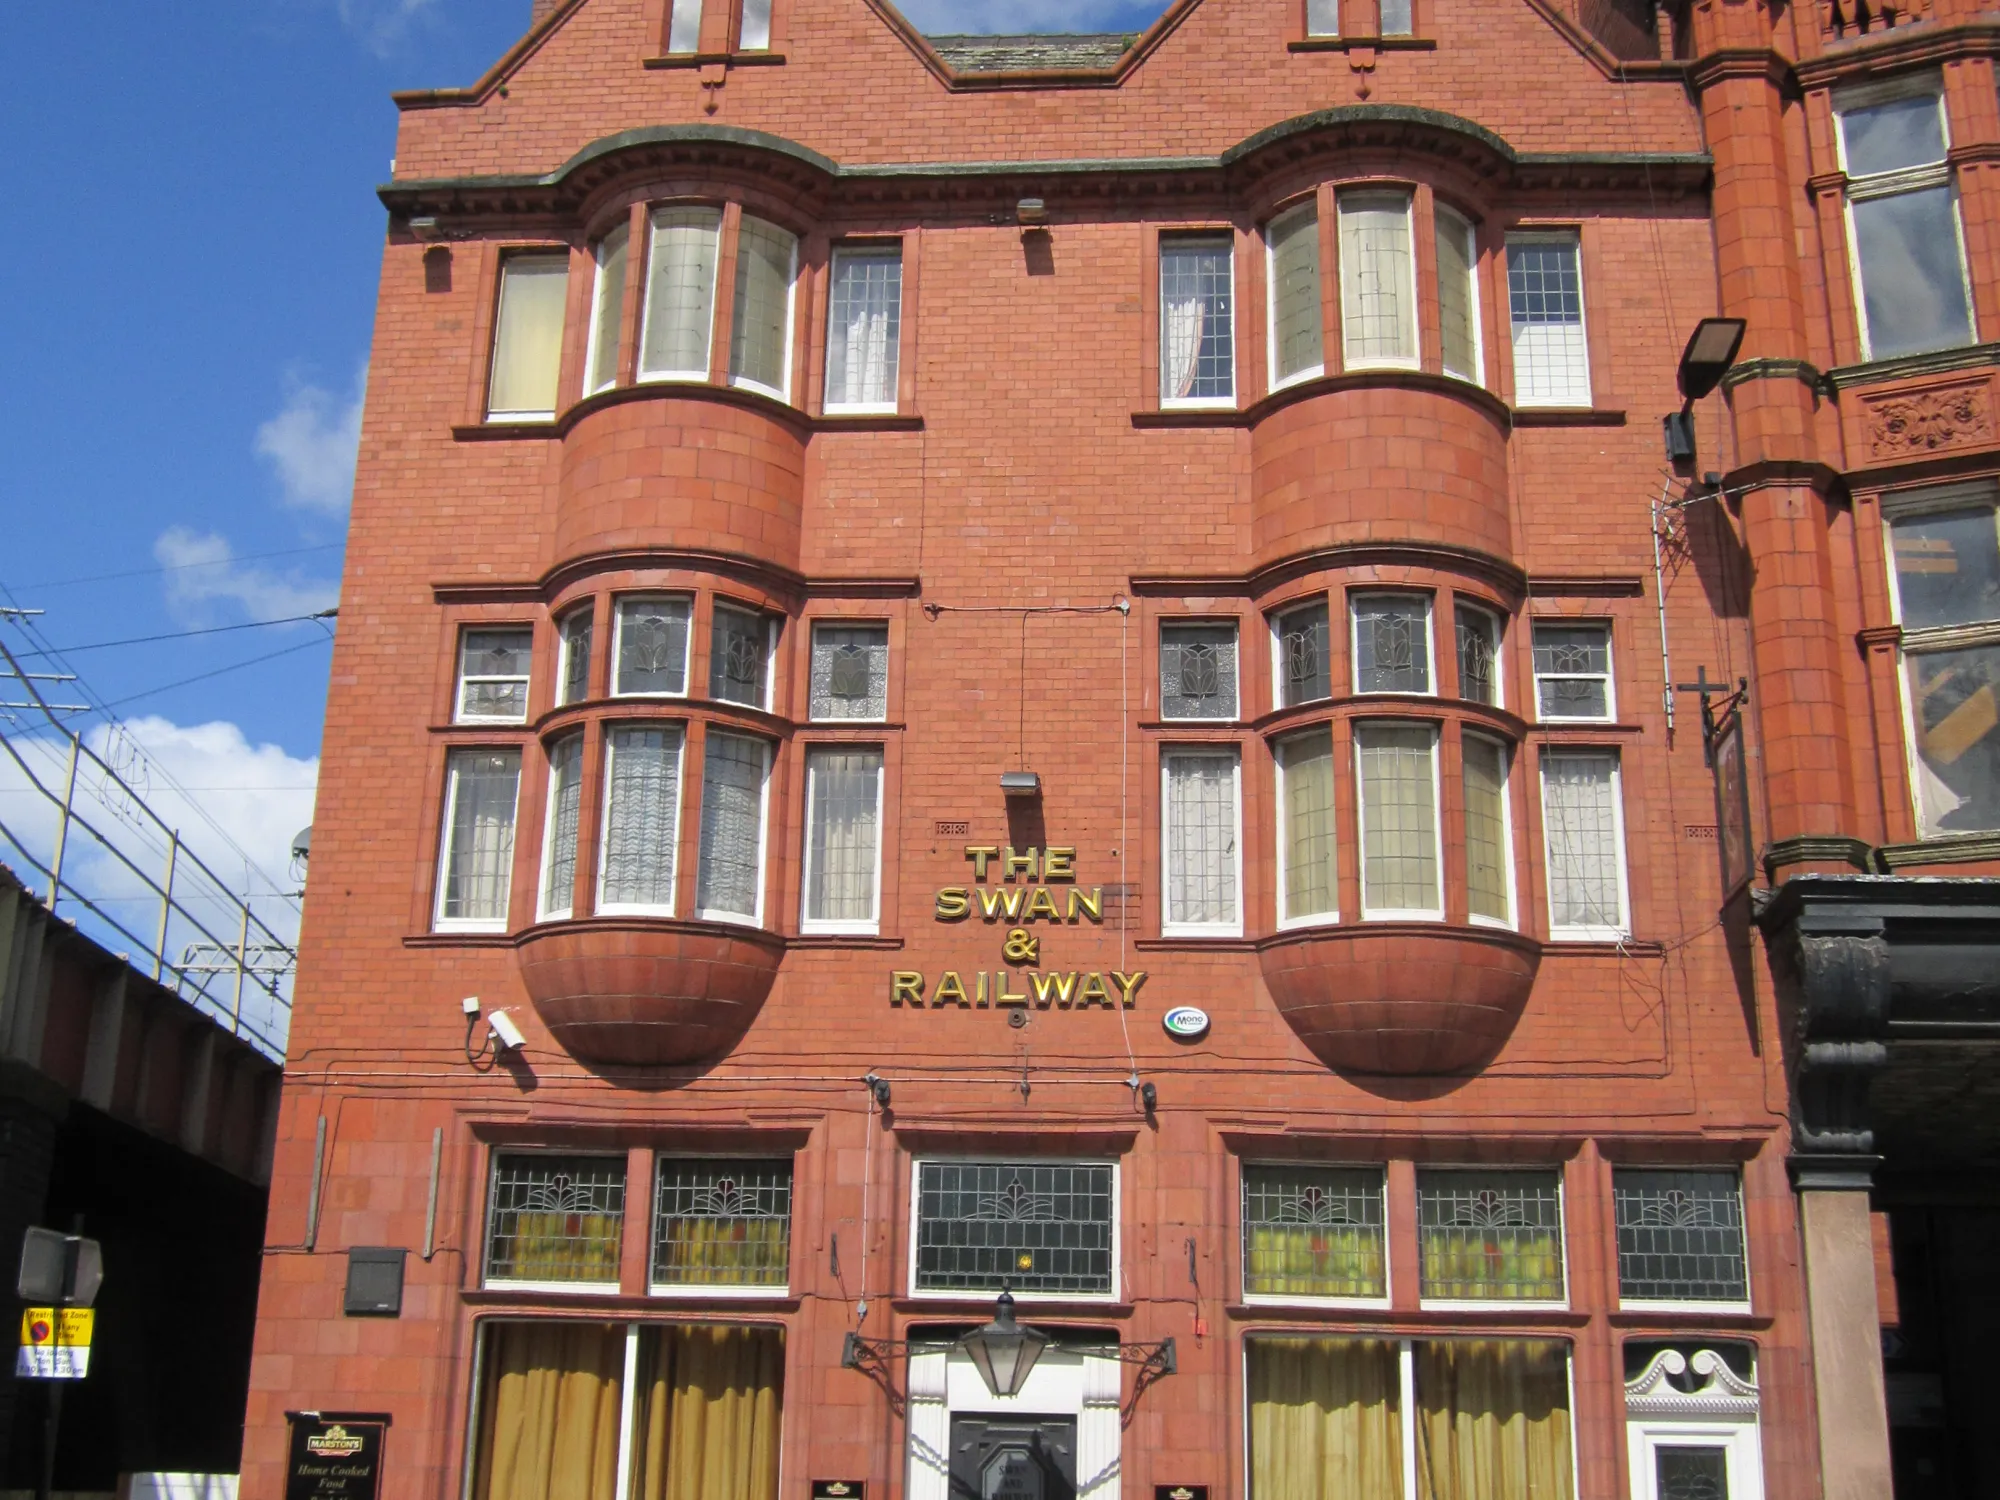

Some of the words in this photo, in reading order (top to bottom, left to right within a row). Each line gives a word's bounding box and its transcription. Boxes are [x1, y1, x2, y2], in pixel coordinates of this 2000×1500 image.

[965, 846, 1076, 881] THE
[935, 887, 1104, 922] SWAN
[1002, 928, 1040, 964] &
[890, 970, 1148, 1009] RAILWAY
[30, 1311, 68, 1319] Restried
[70, 1311, 89, 1319] Zone
[310, 1440, 360, 1449] MARSTON'S
[298, 1465, 328, 1476] Home
[330, 1465, 370, 1476] Cooked
[318, 1478, 346, 1489] Food
